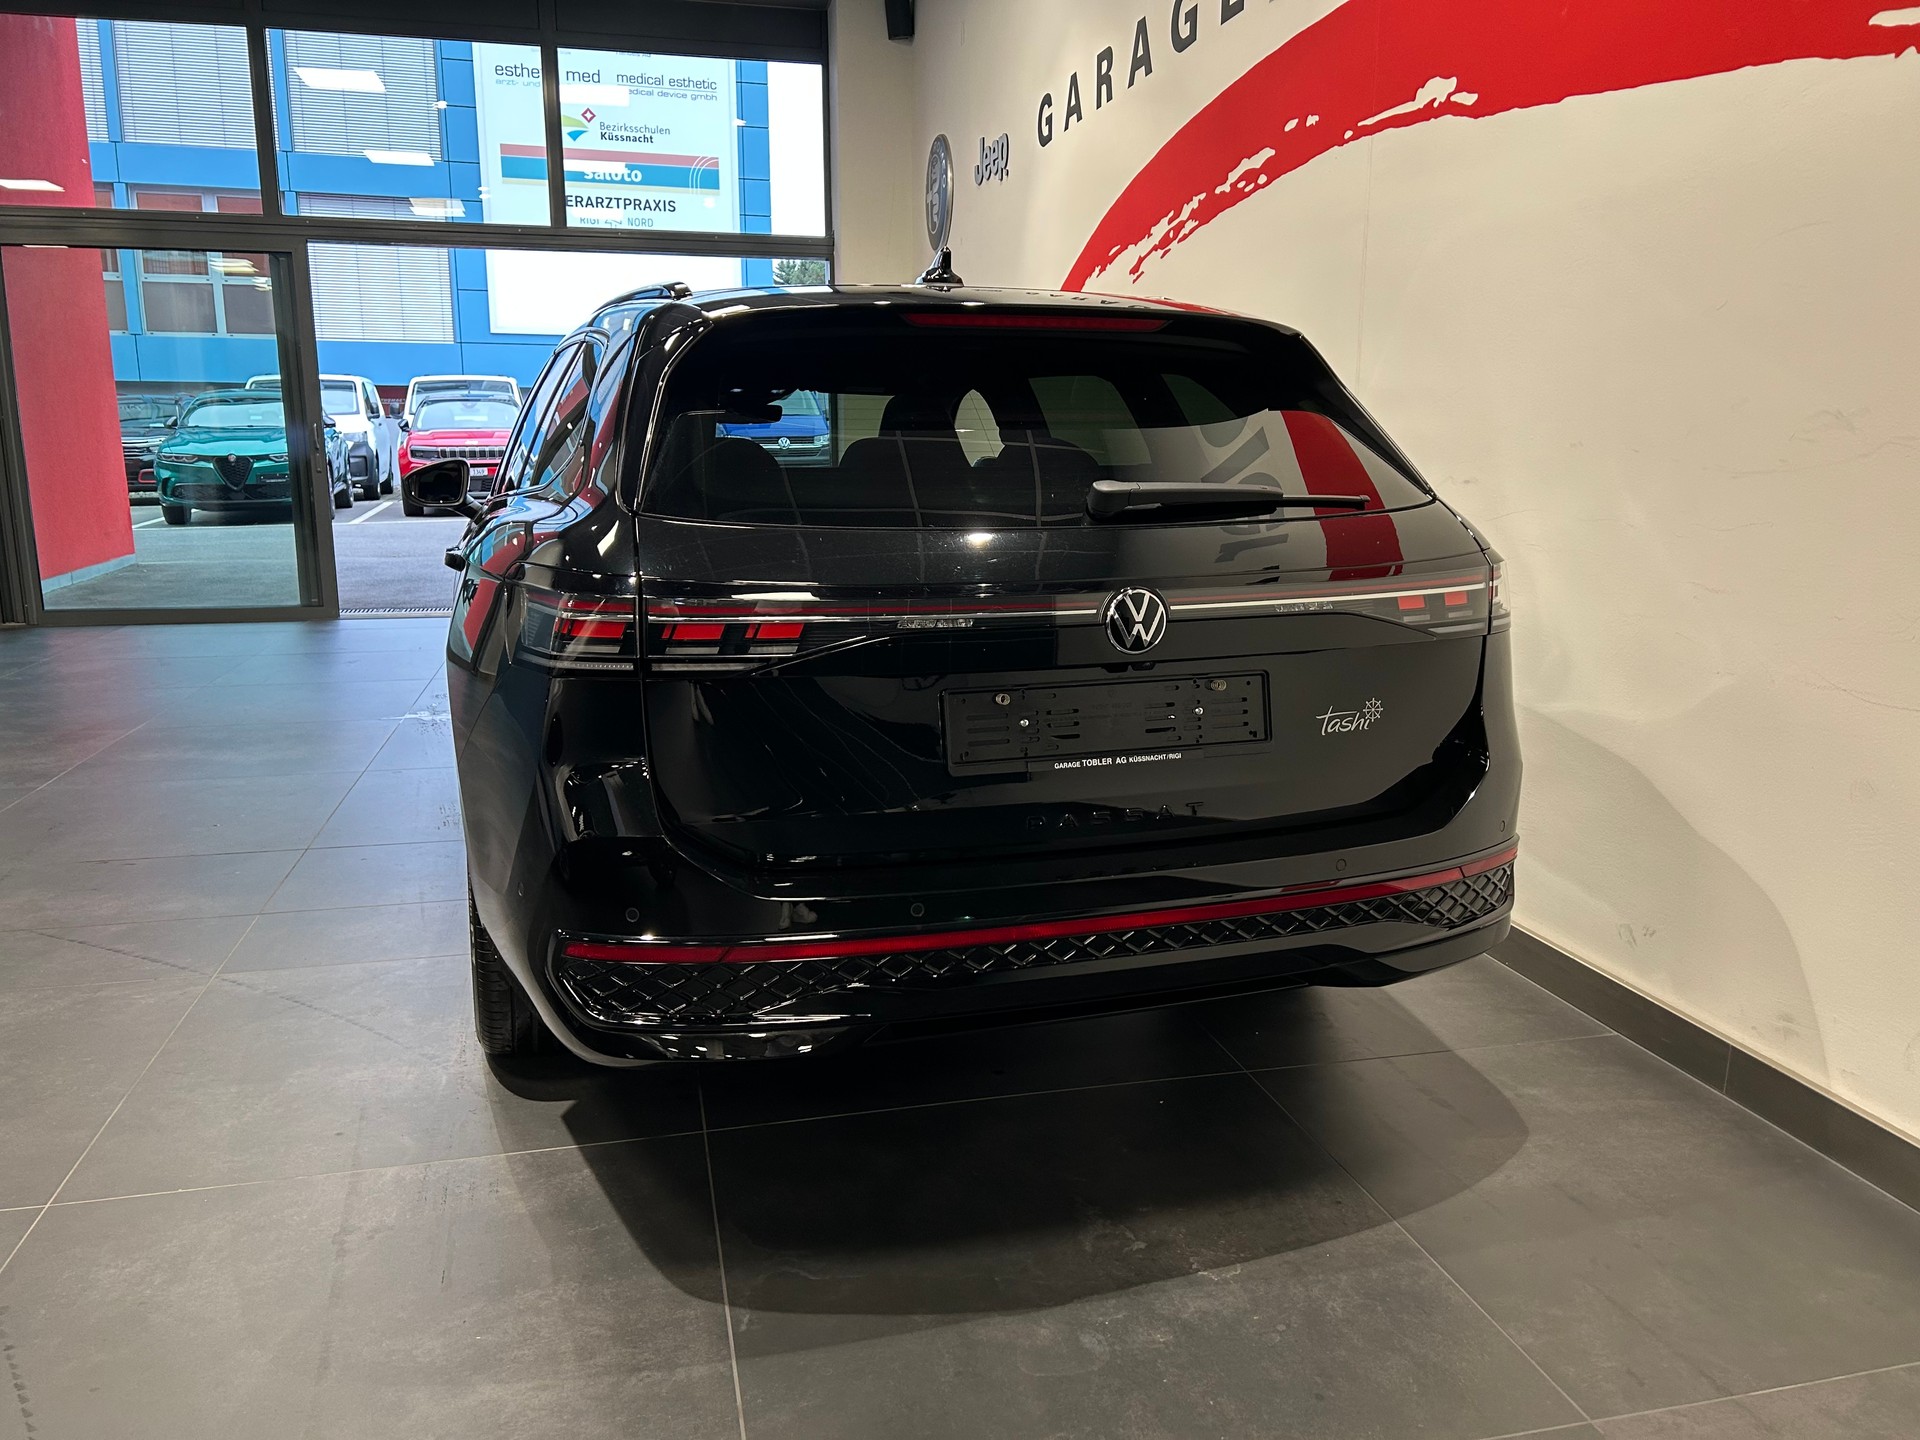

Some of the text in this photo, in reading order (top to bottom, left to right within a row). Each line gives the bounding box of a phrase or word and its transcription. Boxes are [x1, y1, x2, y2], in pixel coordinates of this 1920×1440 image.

[494, 62, 601, 83] esthe med
[616, 73, 717, 90] medical esthetic
[628, 88, 718, 102] dical device gmbh
[599, 121, 671, 135] Bezirksschulen
[600, 131, 654, 144] Küssnacht
[974, 132, 1010, 187] Jeep
[566, 194, 677, 213] ERARZTPRAXIS
[627, 217, 654, 228] NORD
[1054, 761, 1081, 770] GARAGE
[1082, 757, 1113, 767] TOBLER
[1115, 756, 1127, 765] AG
